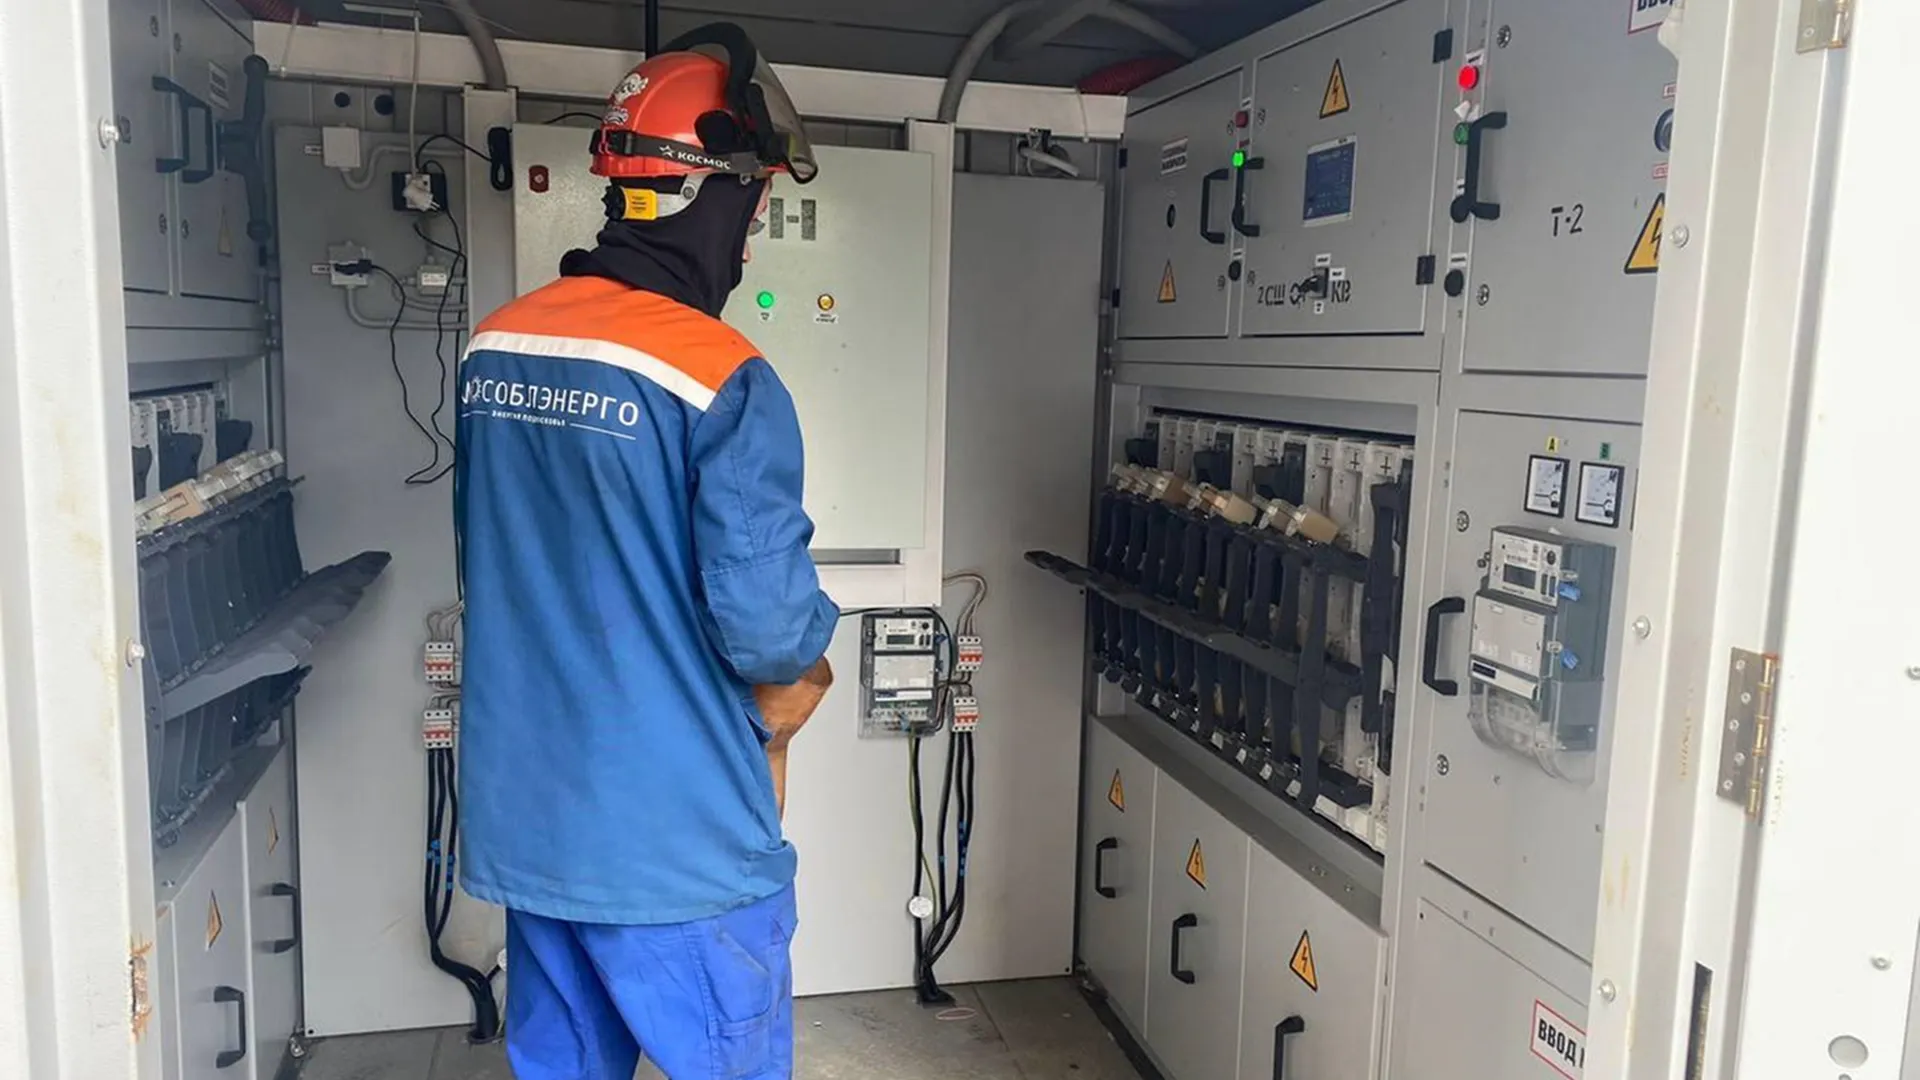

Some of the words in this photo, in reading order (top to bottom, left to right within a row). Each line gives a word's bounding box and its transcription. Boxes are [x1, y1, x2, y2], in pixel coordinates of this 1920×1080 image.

[678, 152, 731, 170] КОСМОС
[748, 197, 816, 241] Н
[1538, 1018, 1577, 1068] ВВОД
